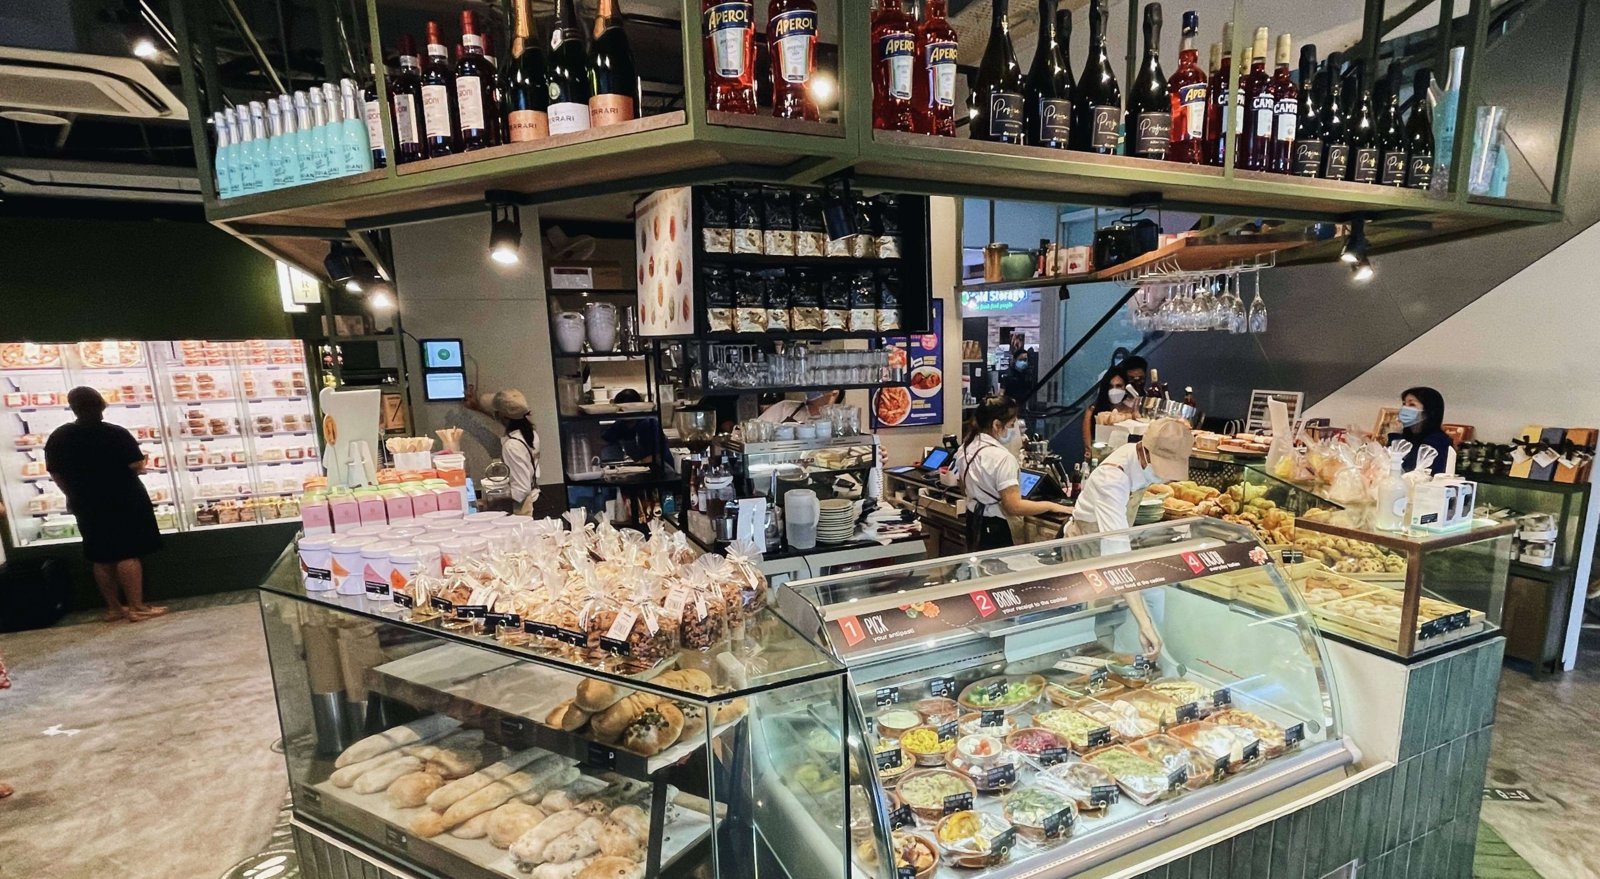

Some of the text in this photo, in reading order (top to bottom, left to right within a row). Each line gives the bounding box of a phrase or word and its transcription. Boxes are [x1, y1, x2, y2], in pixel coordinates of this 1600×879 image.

[708, 9, 749, 31] APEROL
[775, 17, 814, 37] APEROL
[1187, 555, 1200, 567] 4
[1088, 573, 1101, 588] 3
[975, 595, 992, 611] 2
[991, 588, 1022, 610] BRING
[1002, 606, 1015, 615] your
[1015, 603, 1033, 613] receipt
[1040, 599, 1049, 607] the
[844, 621, 857, 637] 1
[863, 614, 889, 635] PICK
[872, 635, 888, 643] your
